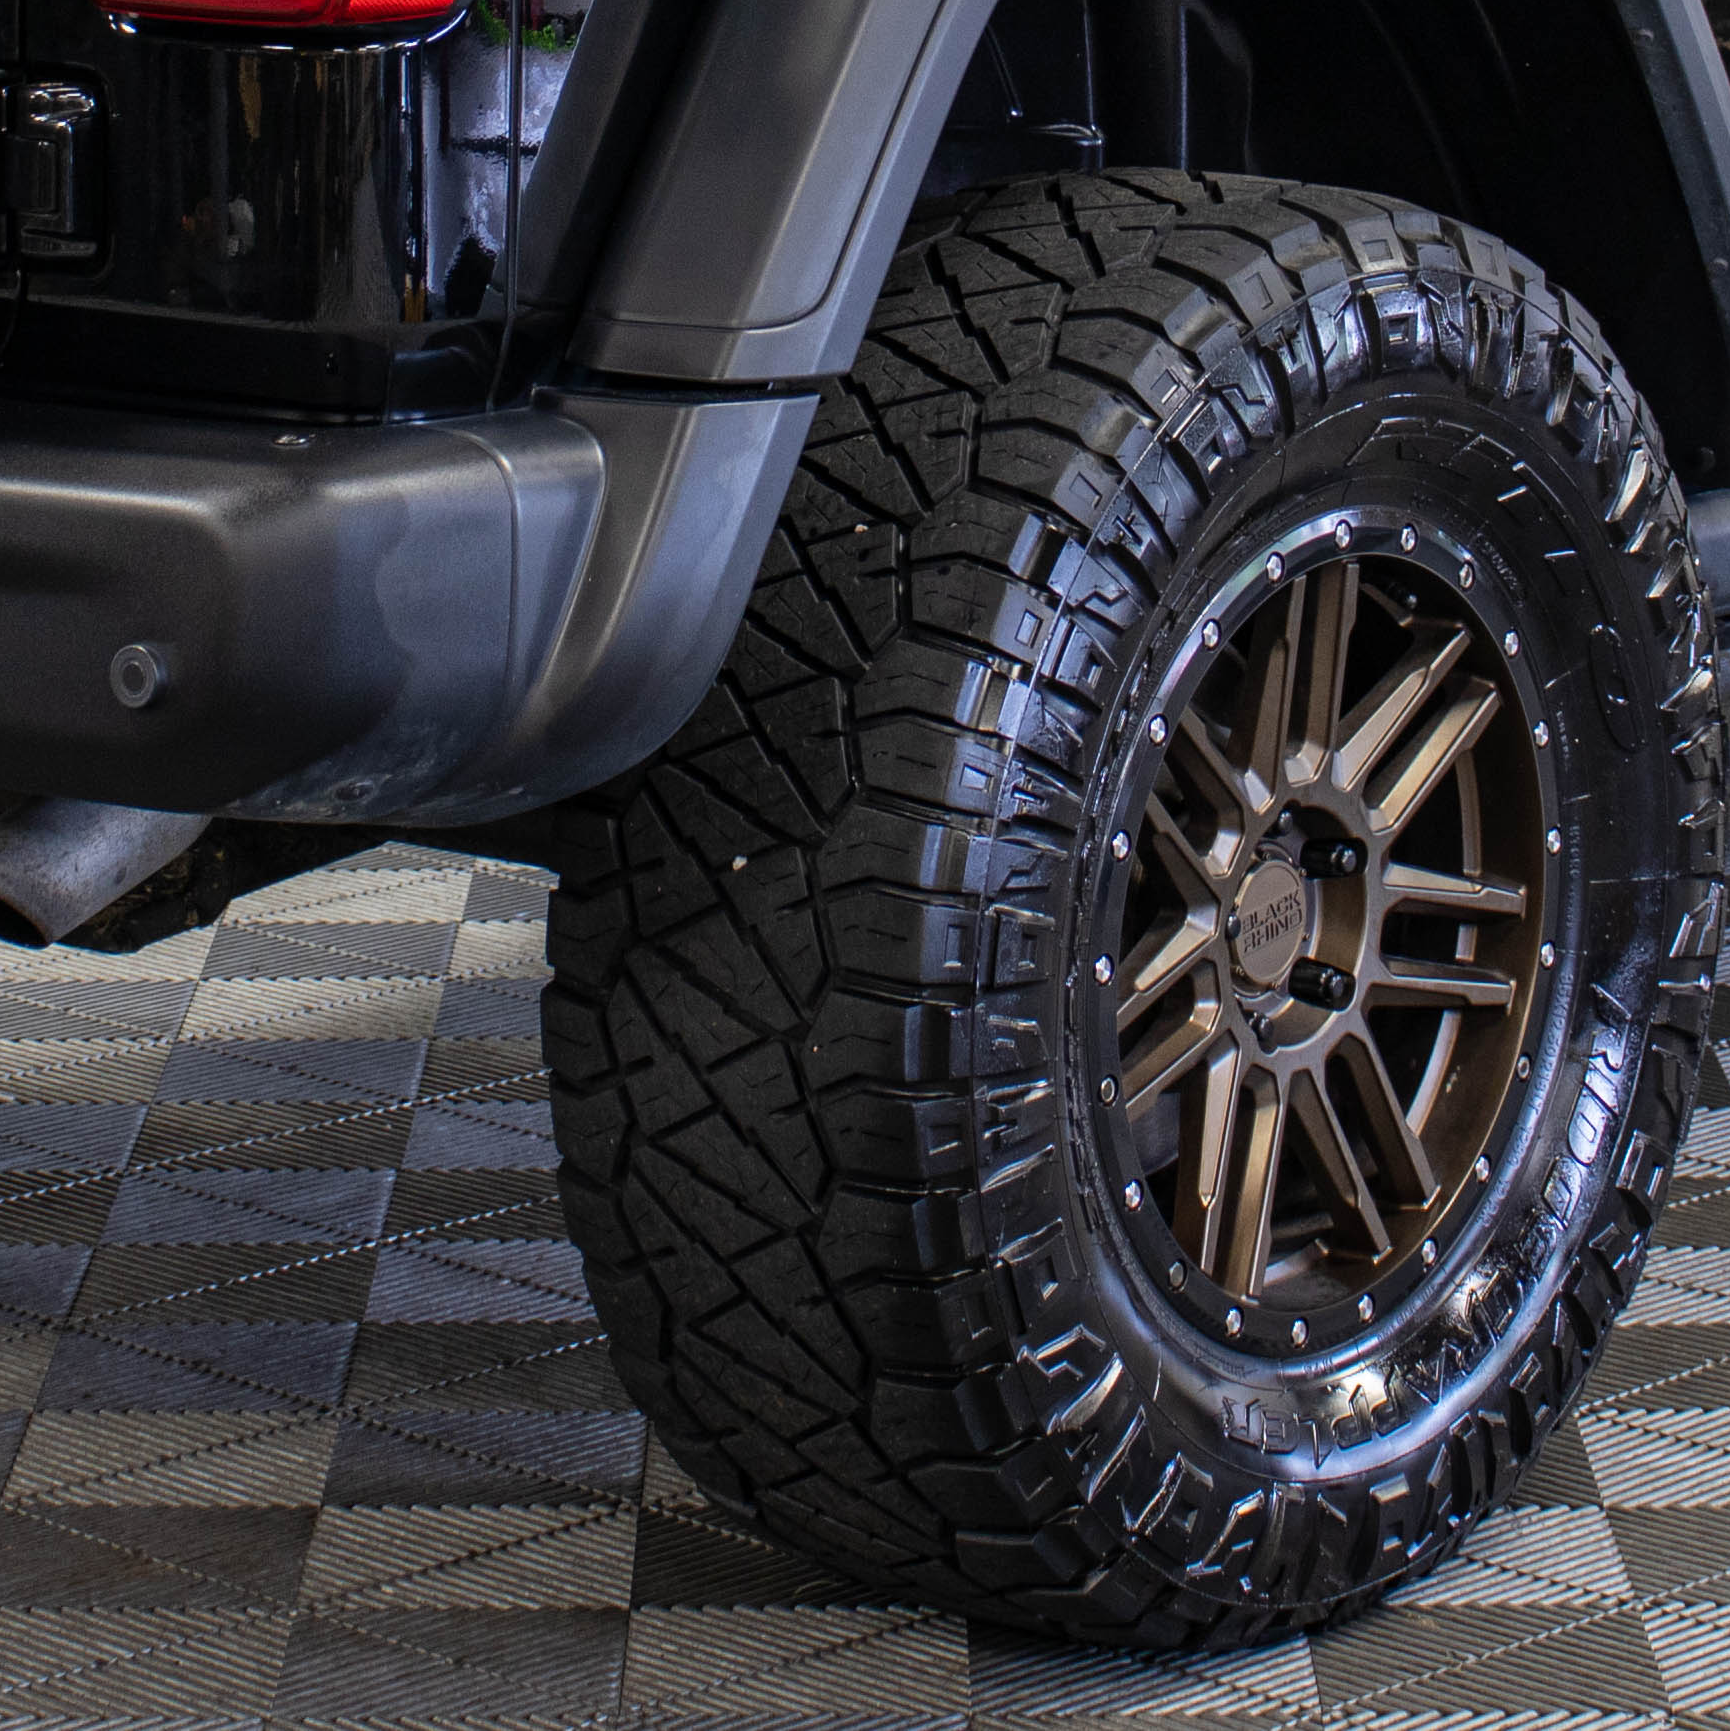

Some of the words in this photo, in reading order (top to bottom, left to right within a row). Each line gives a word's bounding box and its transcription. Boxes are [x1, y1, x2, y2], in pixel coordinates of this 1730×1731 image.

[1243, 889, 1300, 934] BLACK
[1244, 909, 1302, 953] RHINO
[1523, 983, 1633, 1264] RIDGE
